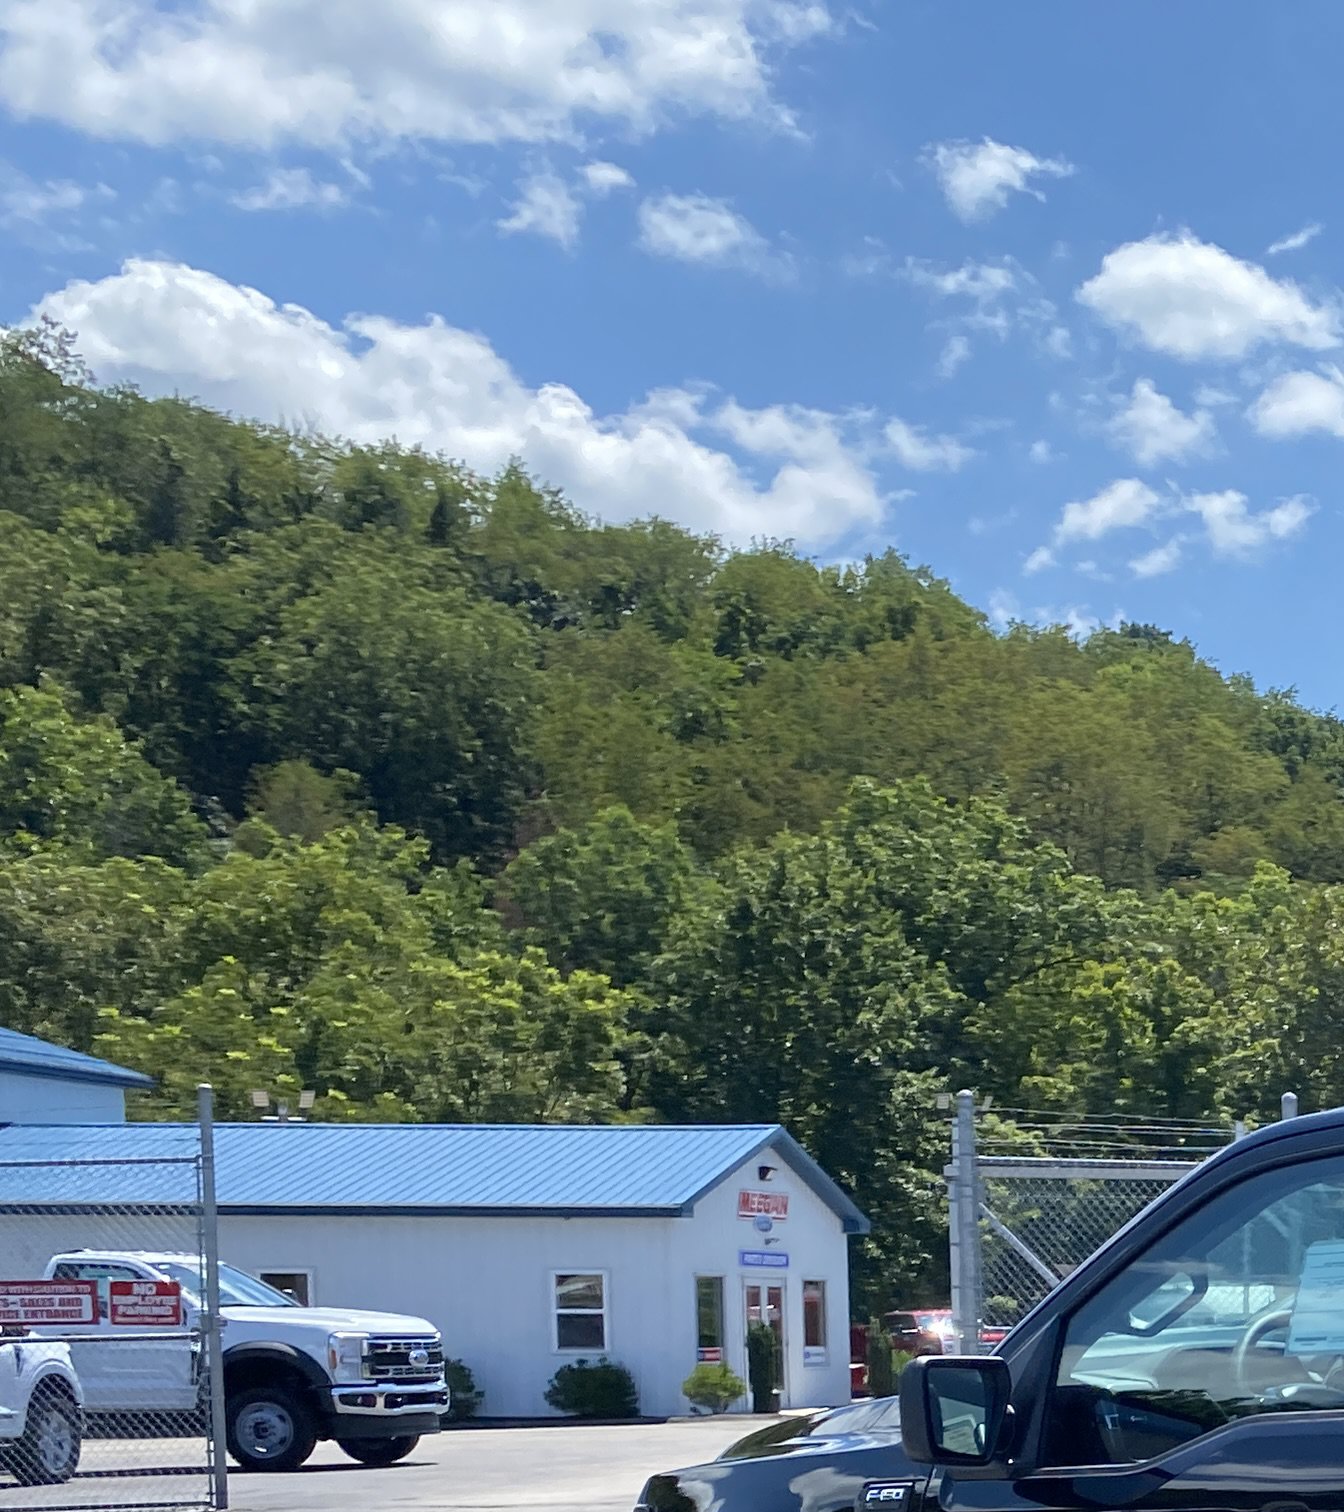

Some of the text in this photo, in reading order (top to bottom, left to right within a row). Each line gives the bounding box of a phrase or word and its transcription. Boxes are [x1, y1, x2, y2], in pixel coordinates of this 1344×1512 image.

[132, 1283, 157, 1295] NO
[20, 1297, 55, 1308] SALES
[58, 1297, 83, 1308] AND
[24, 1309, 83, 1319] ENTRANCE
